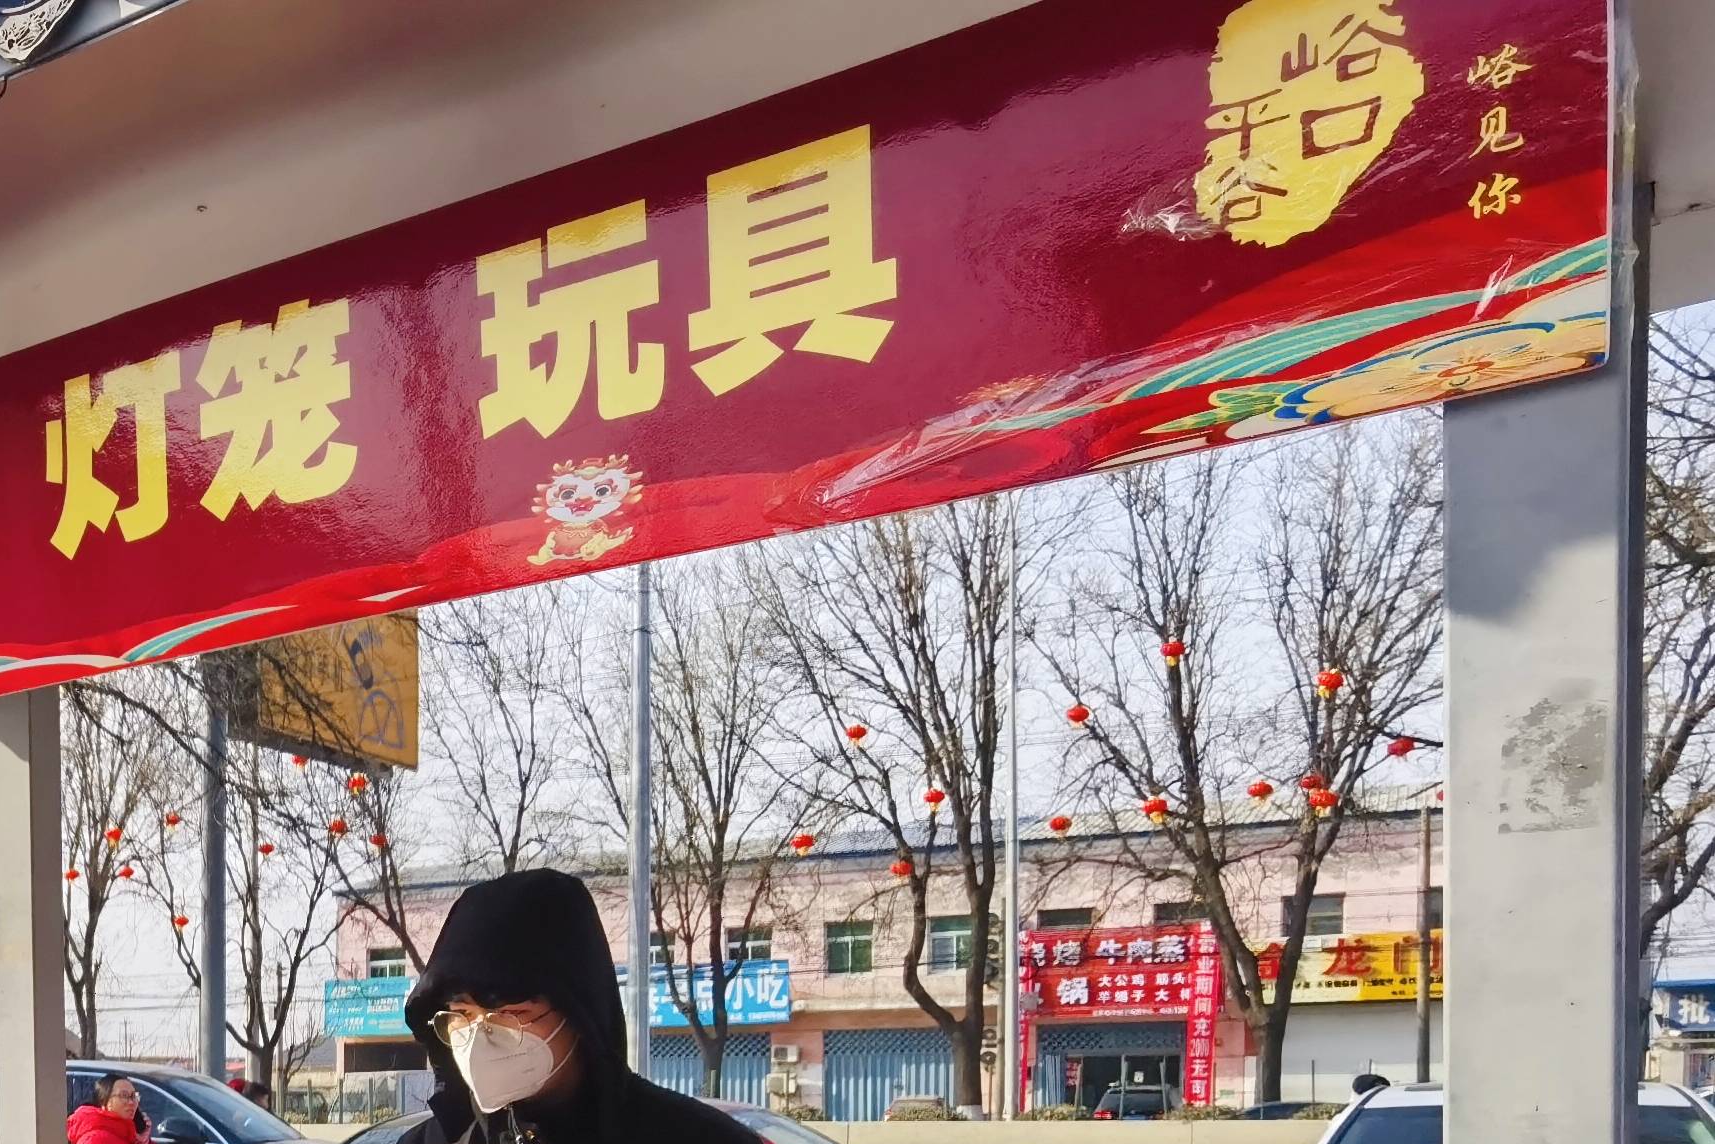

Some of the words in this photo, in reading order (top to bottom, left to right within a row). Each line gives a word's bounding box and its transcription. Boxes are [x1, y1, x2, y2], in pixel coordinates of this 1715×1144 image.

[1205, 88, 1290, 225] 平谷
[1281, 13, 1406, 159] 峪口
[1468, 44, 1533, 219] 峪见你
[46, 299, 357, 560] 灯笼
[476, 124, 897, 440] 玩具
[1096, 935, 1190, 965] 牛肉蒸
[1156, 972, 1191, 985] 筋头
